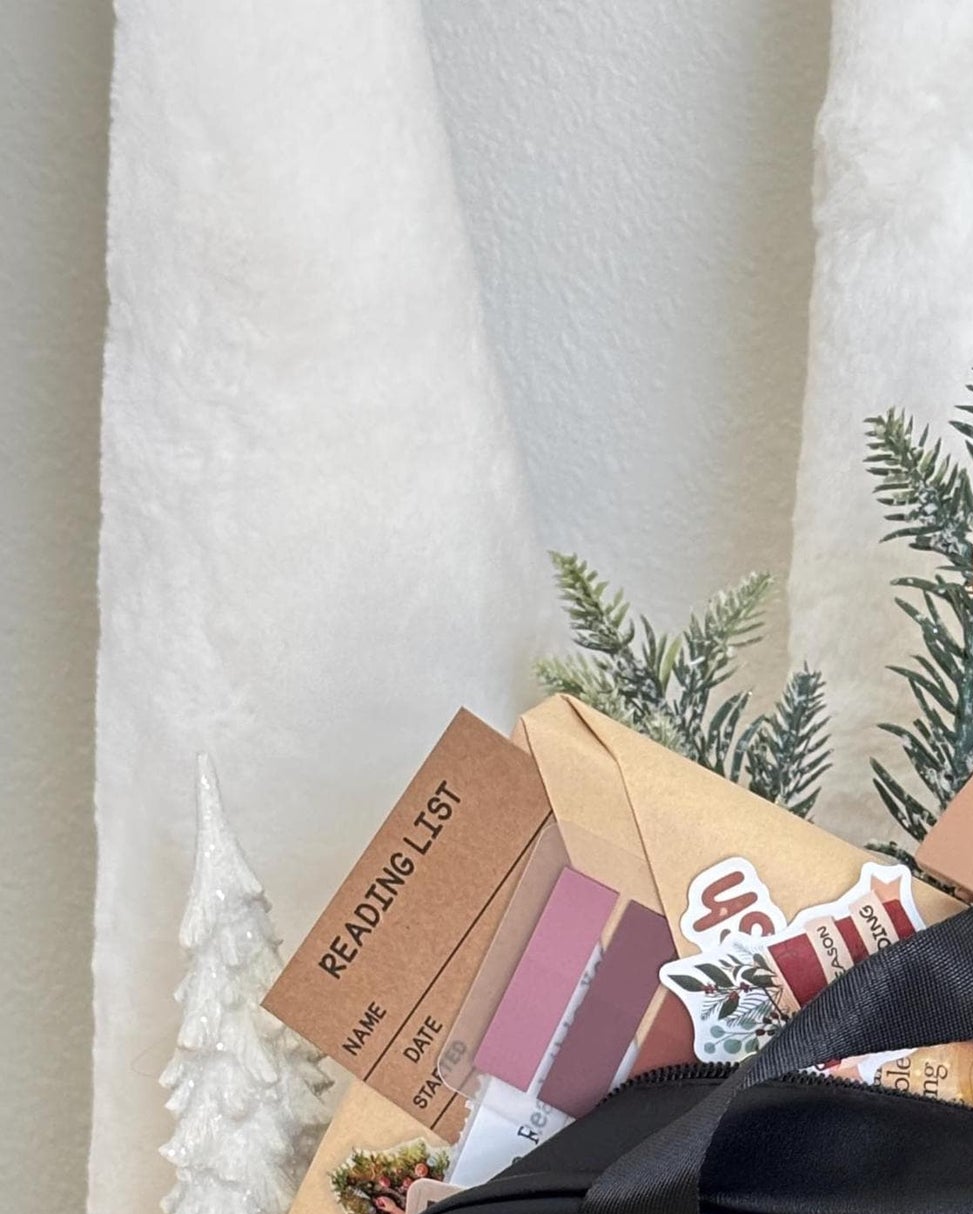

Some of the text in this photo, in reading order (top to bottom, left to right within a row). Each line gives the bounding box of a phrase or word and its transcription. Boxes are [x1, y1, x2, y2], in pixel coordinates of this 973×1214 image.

[318, 780, 461, 979] READING LIST
[342, 1001, 387, 1056] NAME
[403, 1015, 443, 1063] DATE
